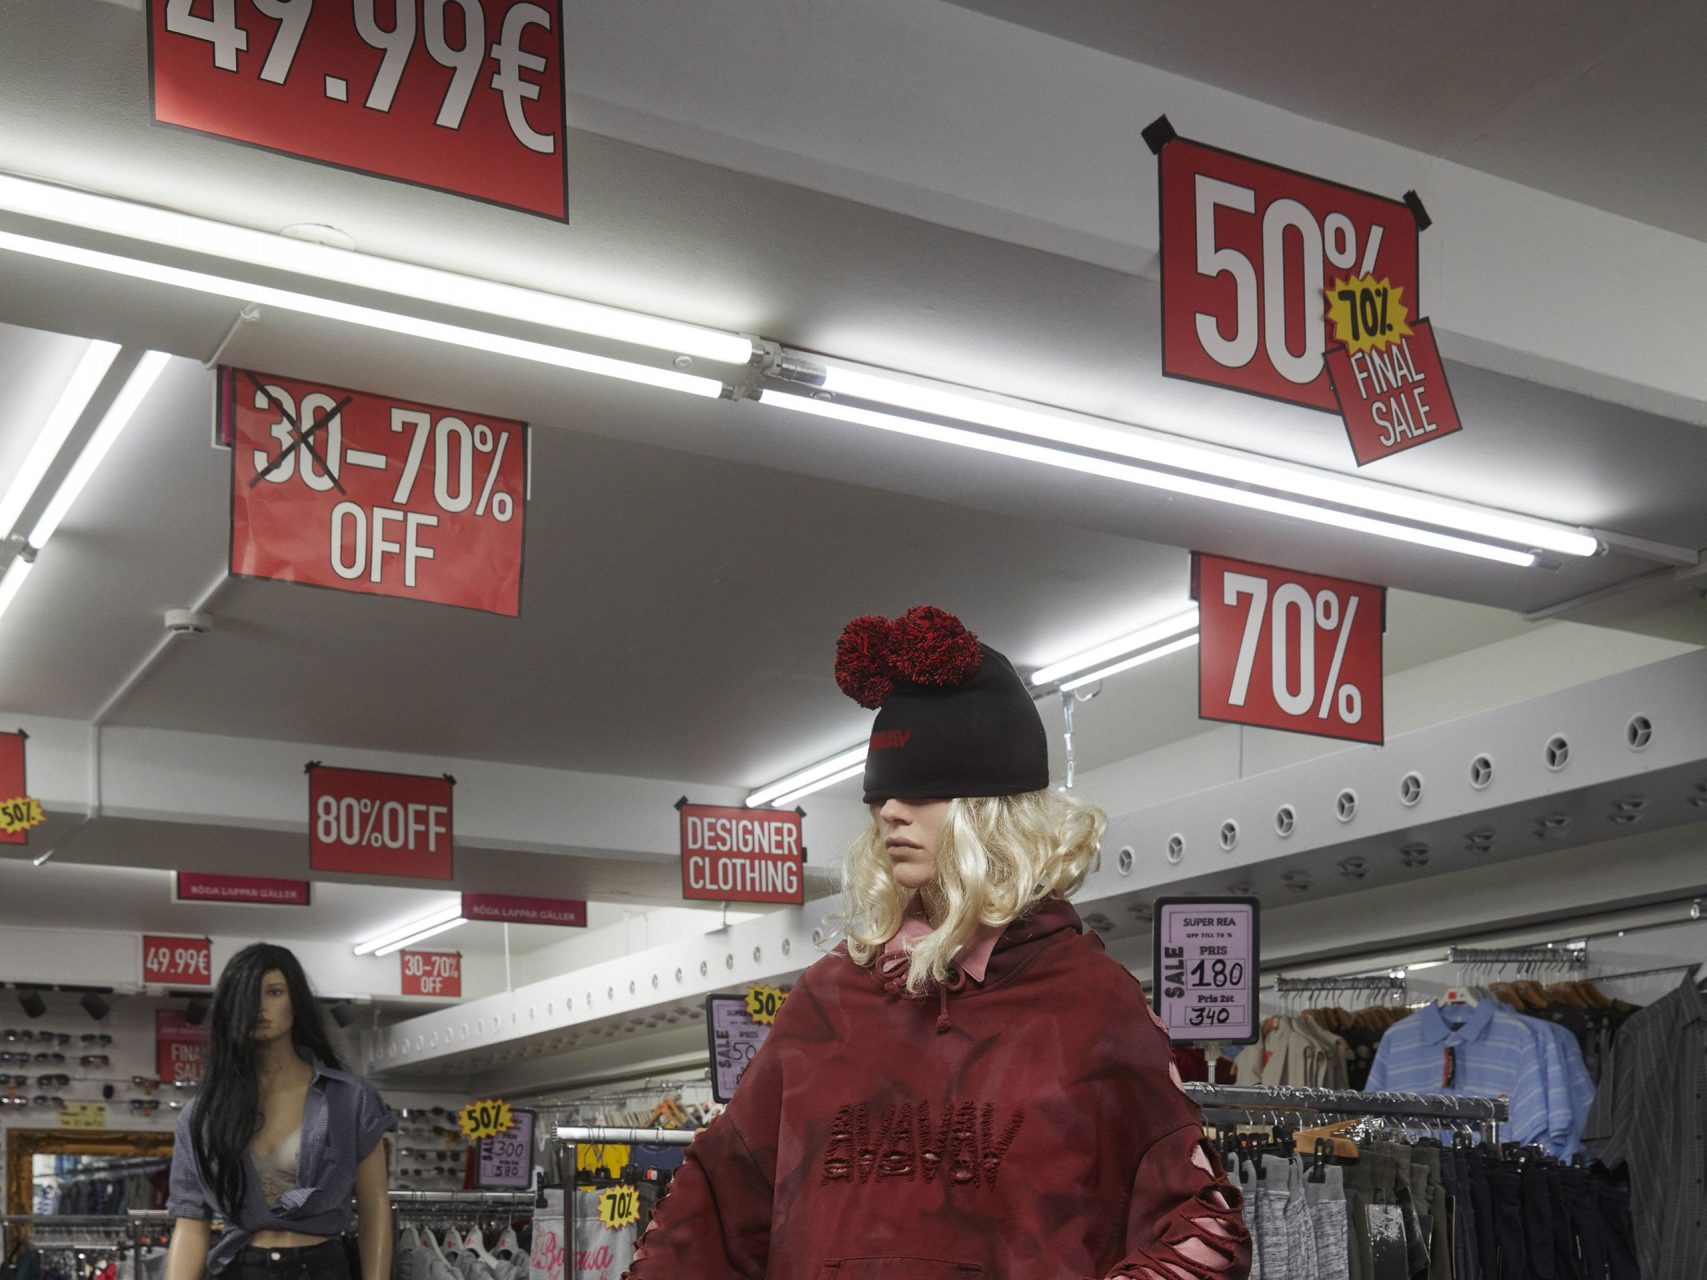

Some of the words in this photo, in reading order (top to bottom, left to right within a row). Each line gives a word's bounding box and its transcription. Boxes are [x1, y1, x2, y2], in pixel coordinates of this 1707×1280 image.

[1338, 286, 1393, 342] 70%
[1350, 338, 1425, 400] FINAL
[1371, 386, 1437, 447] SALE
[329, 501, 439, 588] OFF
[1223, 571, 1362, 724] 70%
[1, 801, 36, 827] 50%
[687, 816, 798, 856] DESIGNER
[689, 855, 798, 894] CLOTHING
[1183, 917, 1215, 927] SUPER
[1216, 917, 1237, 927] REA
[146, 947, 209, 975] 49.99€
[1199, 945, 1228, 956] PRIS
[420, 976, 444, 993] OFF
[1164, 946, 1185, 999] SALE
[1191, 958, 1243, 988] 180
[1198, 994, 1219, 1004] Pris
[1189, 1007, 1230, 1027] 340
[716, 1030, 732, 1069] SALE
[467, 1105, 504, 1133] 50%
[482, 1136, 494, 1162] SAL
[494, 1141, 524, 1157] 300
[606, 1192, 632, 1221] 70%
